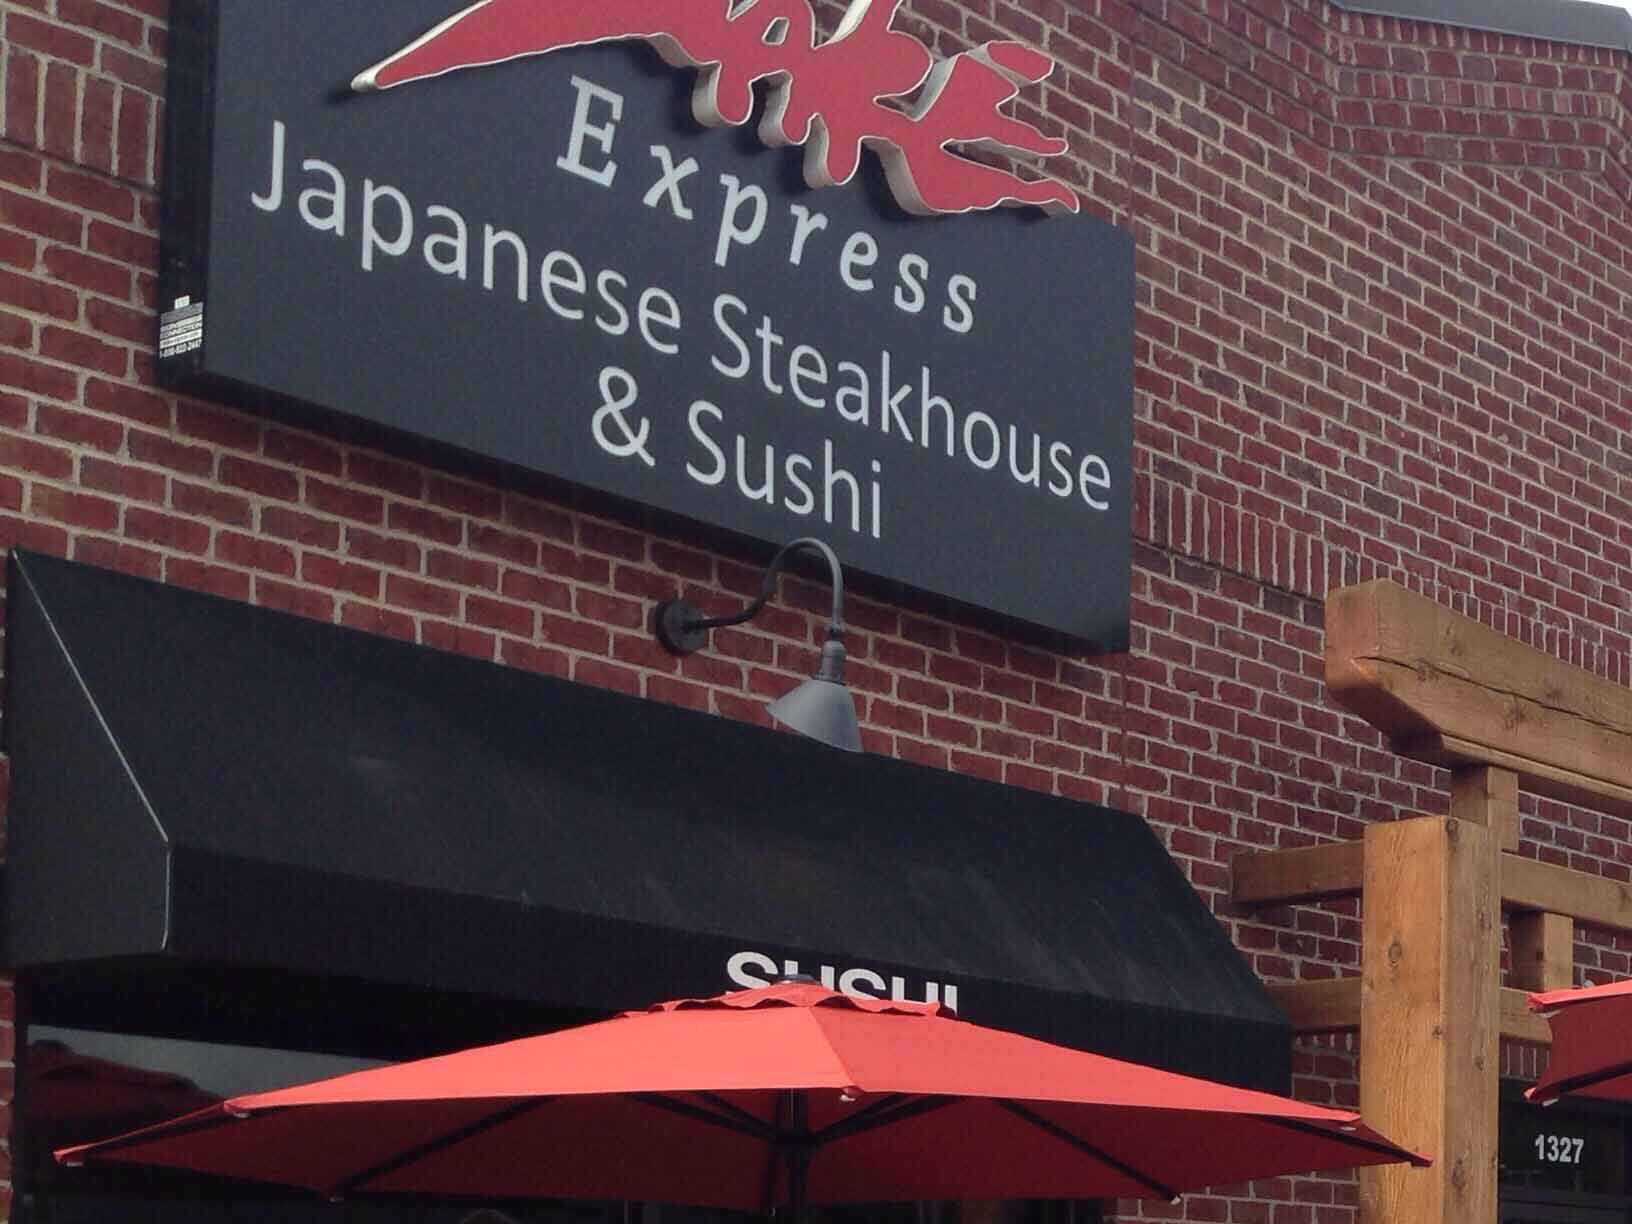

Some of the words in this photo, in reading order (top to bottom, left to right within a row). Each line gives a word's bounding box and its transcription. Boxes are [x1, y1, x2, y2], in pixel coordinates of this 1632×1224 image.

[555, 75, 978, 335] Express
[251, 120, 682, 356] Japanese
[711, 293, 1112, 512] Steakhouse
[591, 366, 656, 467] &
[686, 400, 882, 540] Sushi
[1535, 1133, 1584, 1164] 1327
